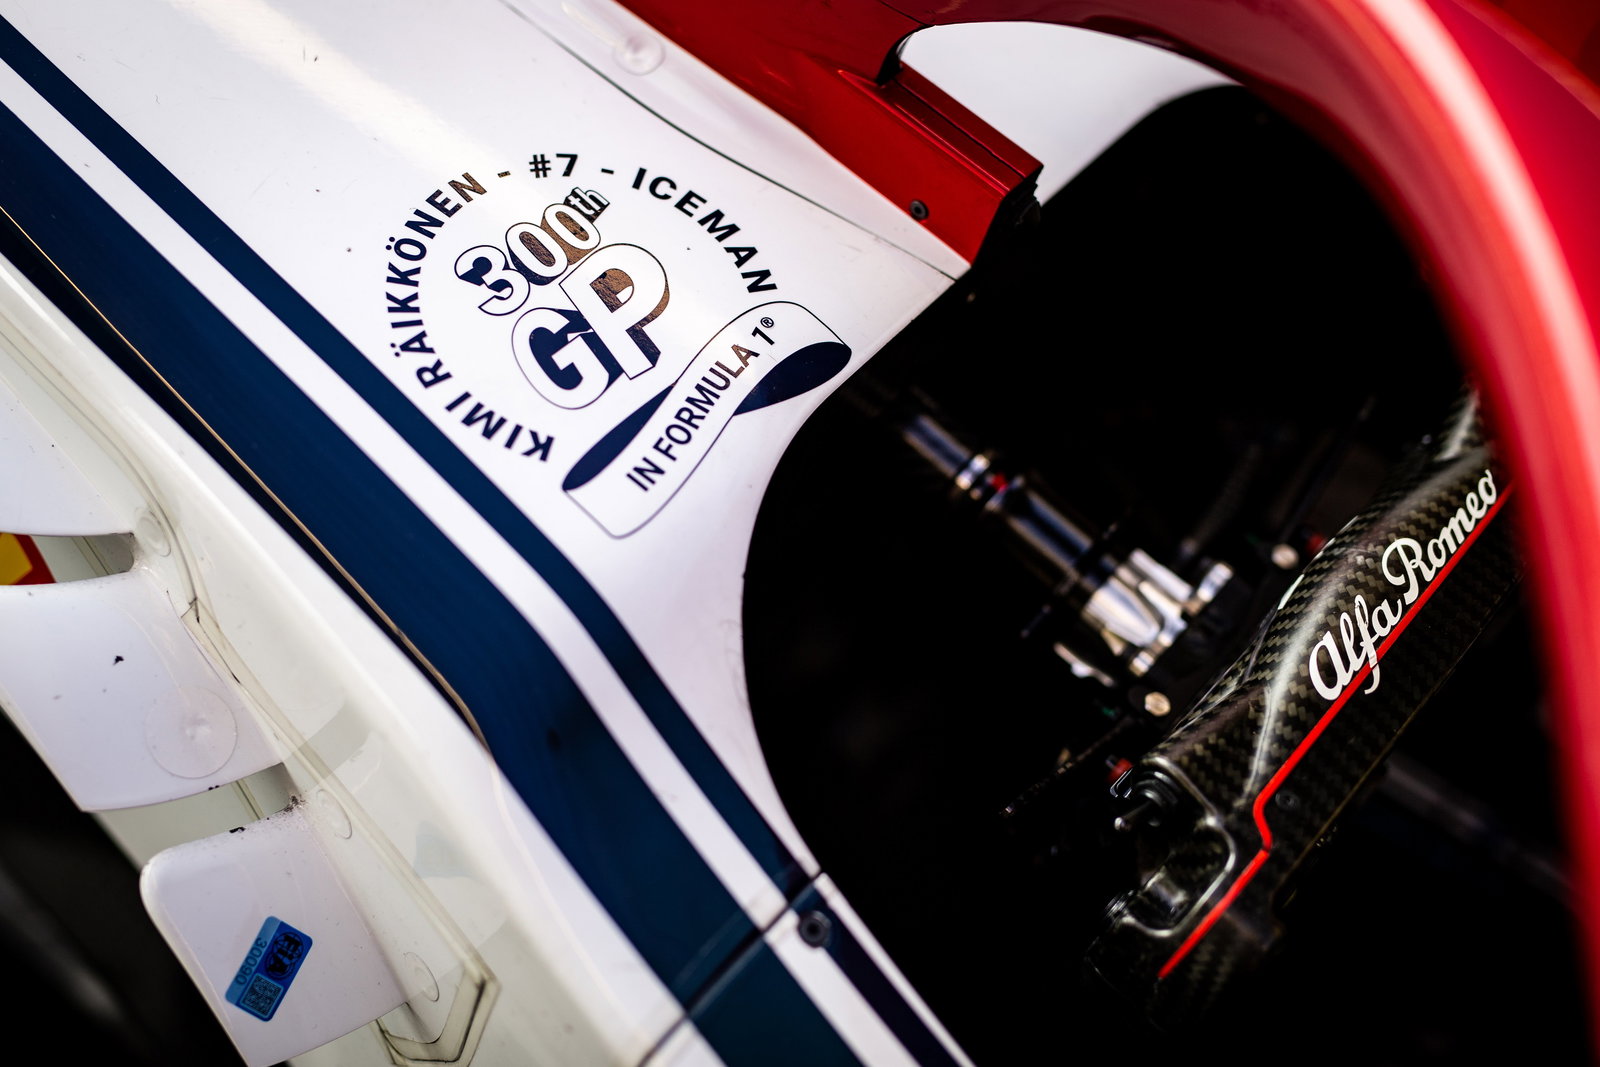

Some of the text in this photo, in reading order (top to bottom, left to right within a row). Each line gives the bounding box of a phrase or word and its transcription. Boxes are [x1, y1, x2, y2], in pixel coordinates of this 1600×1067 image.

[528, 153, 579, 178] #7
[631, 167, 778, 294] ICEMAN
[385, 172, 487, 389] RÄIKKÖNEN
[511, 243, 670, 410] GP
[446, 392, 554, 461] KIMI
[626, 457, 666, 492] IN
[653, 343, 761, 461] FORMULA
[1308, 469, 1497, 700] Alfa Romeo
[235, 938, 268, 985] 30090
